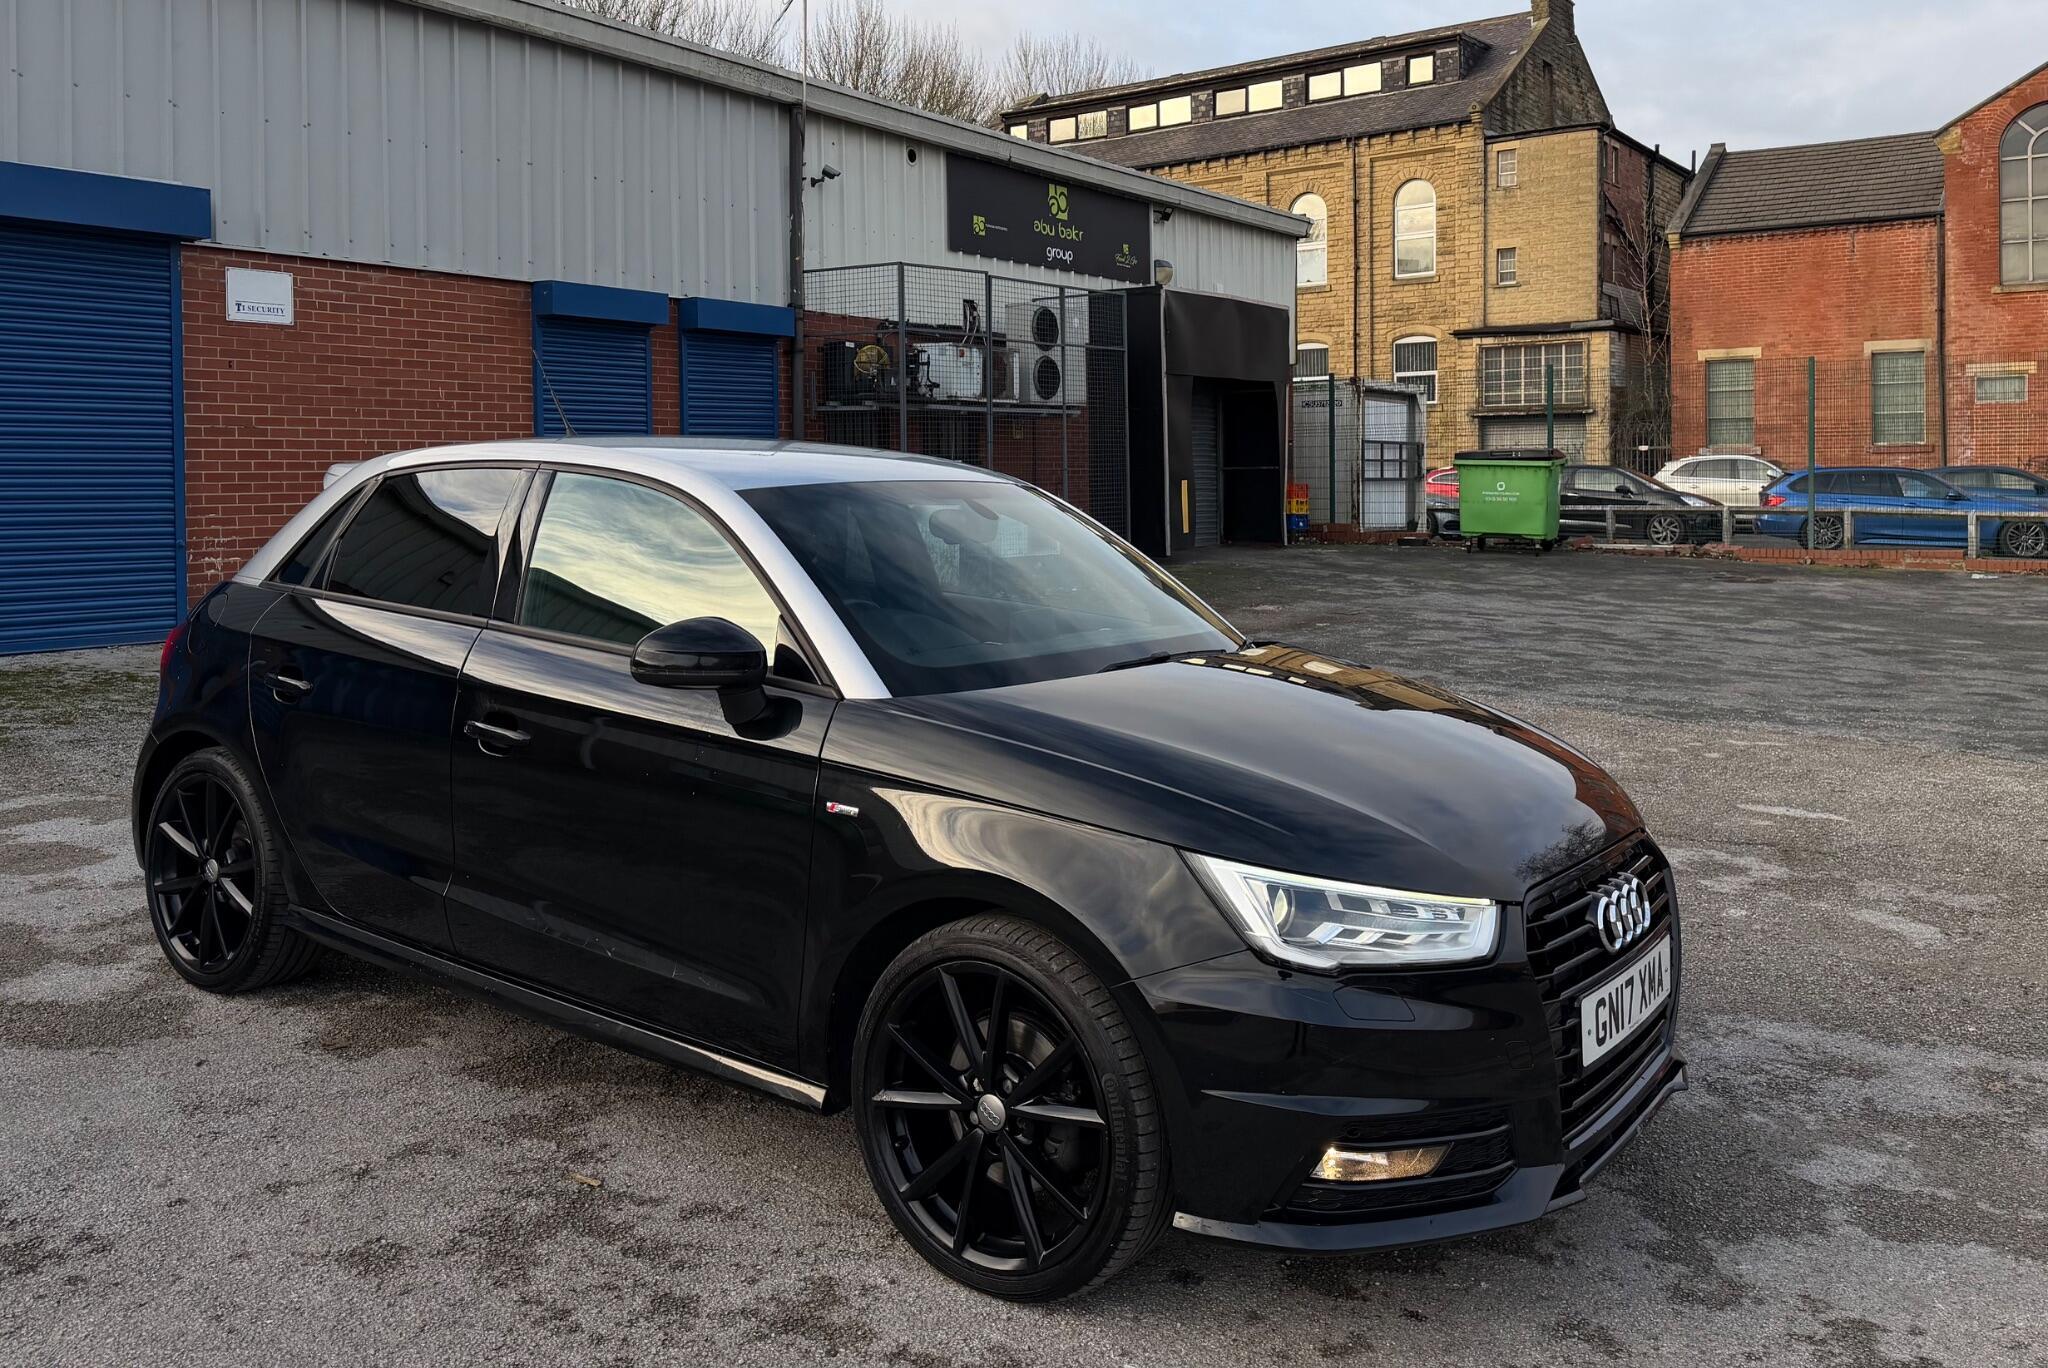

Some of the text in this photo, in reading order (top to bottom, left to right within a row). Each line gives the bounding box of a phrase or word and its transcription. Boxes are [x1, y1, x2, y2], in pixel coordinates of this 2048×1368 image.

[1033, 219, 1085, 242] abu bakr
[1046, 246, 1074, 264] group
[247, 304, 286, 315] SECURITY
[1595, 951, 1664, 1047] GN17 XMA
